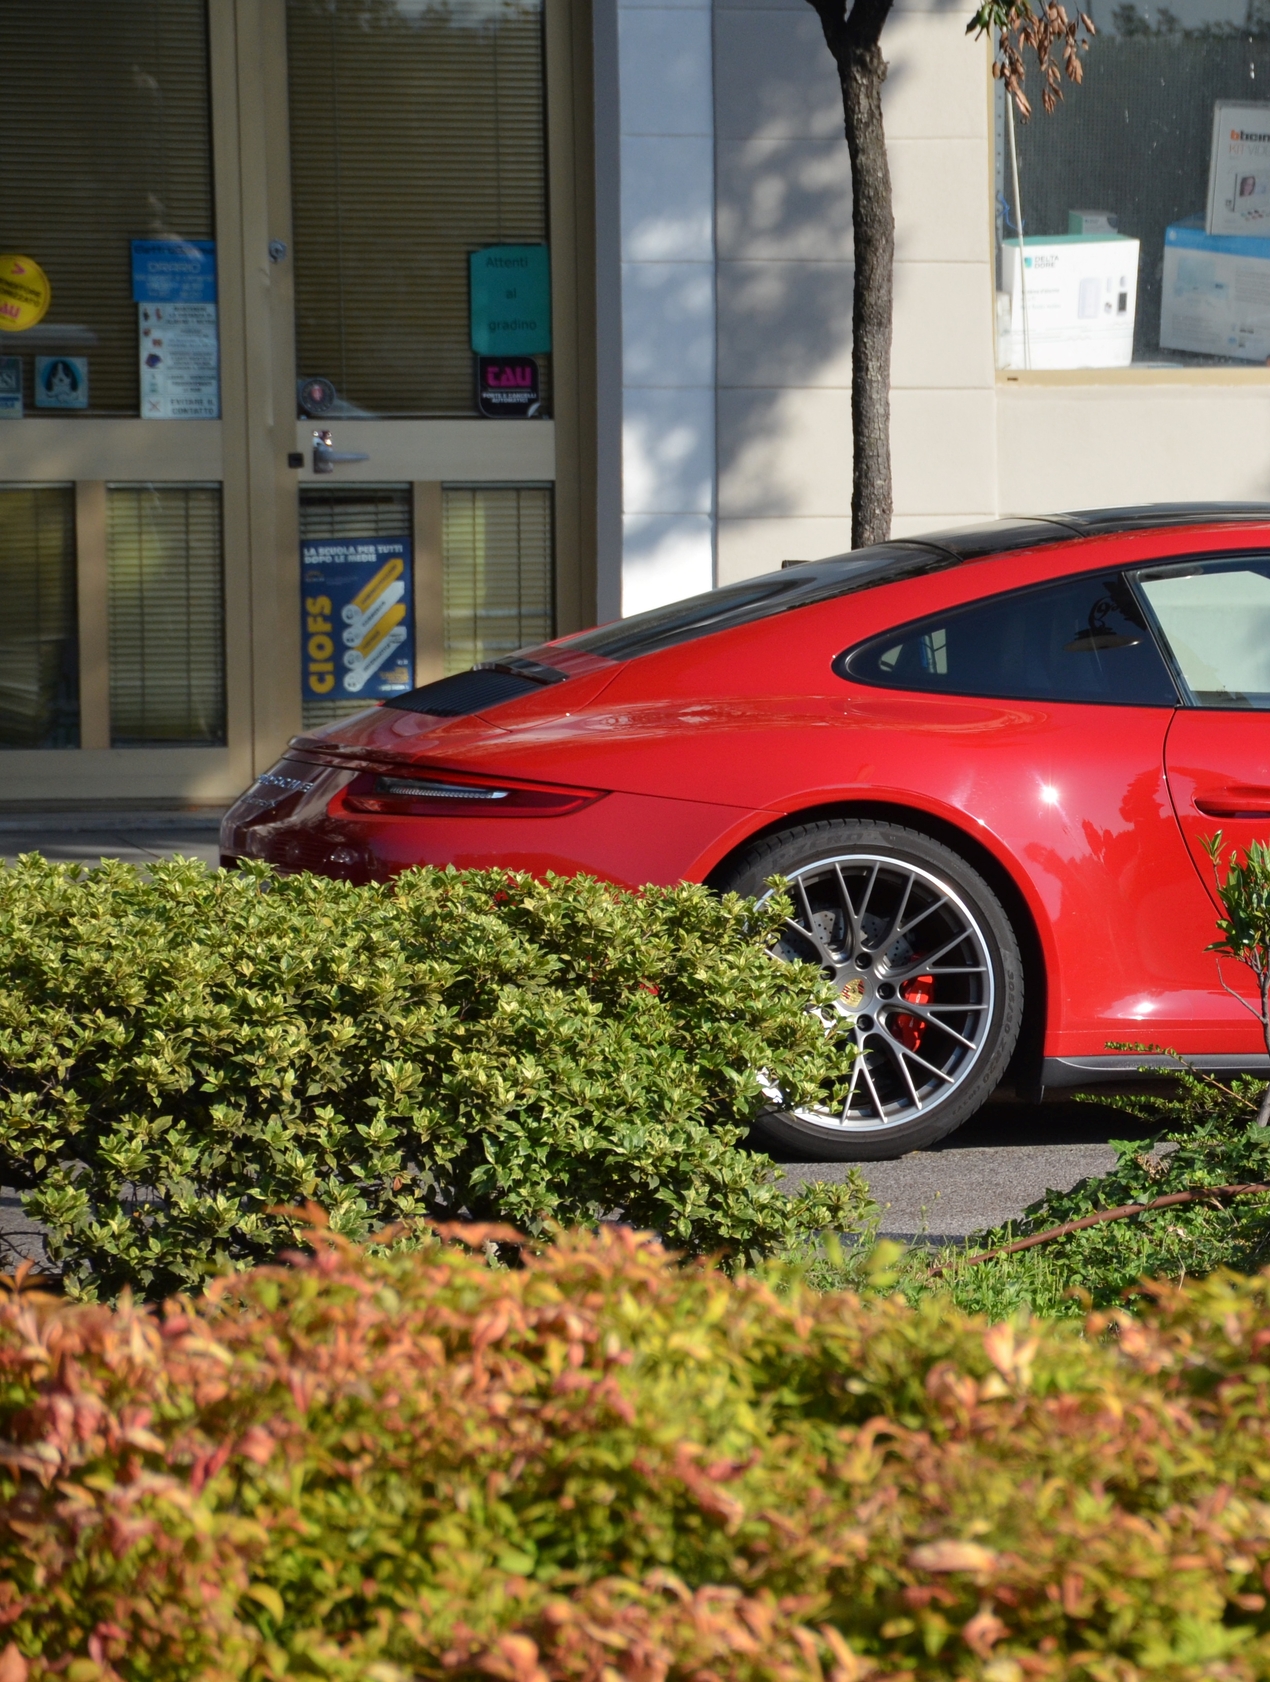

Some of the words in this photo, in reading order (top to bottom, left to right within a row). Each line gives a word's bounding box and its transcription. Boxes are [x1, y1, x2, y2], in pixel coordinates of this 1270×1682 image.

[1229, 144, 1244, 155] KIT
[486, 257, 528, 268] Attenti
[1034, 255, 1060, 263] DELTA
[506, 287, 517, 299] al
[488, 318, 537, 333] gradino
[172, 407, 214, 415] CONTATTO
[304, 547, 317, 556] LA
[318, 546, 356, 556] SCUOLA
[357, 545, 376, 555] PER
[377, 544, 403, 554] TUTTI
[304, 555, 333, 564] DOPO
[334, 555, 346, 563] LE
[348, 554, 377, 563] MEDIE
[305, 595, 336, 694] CIOFS
[1004, 969, 1015, 1035] 305/30
